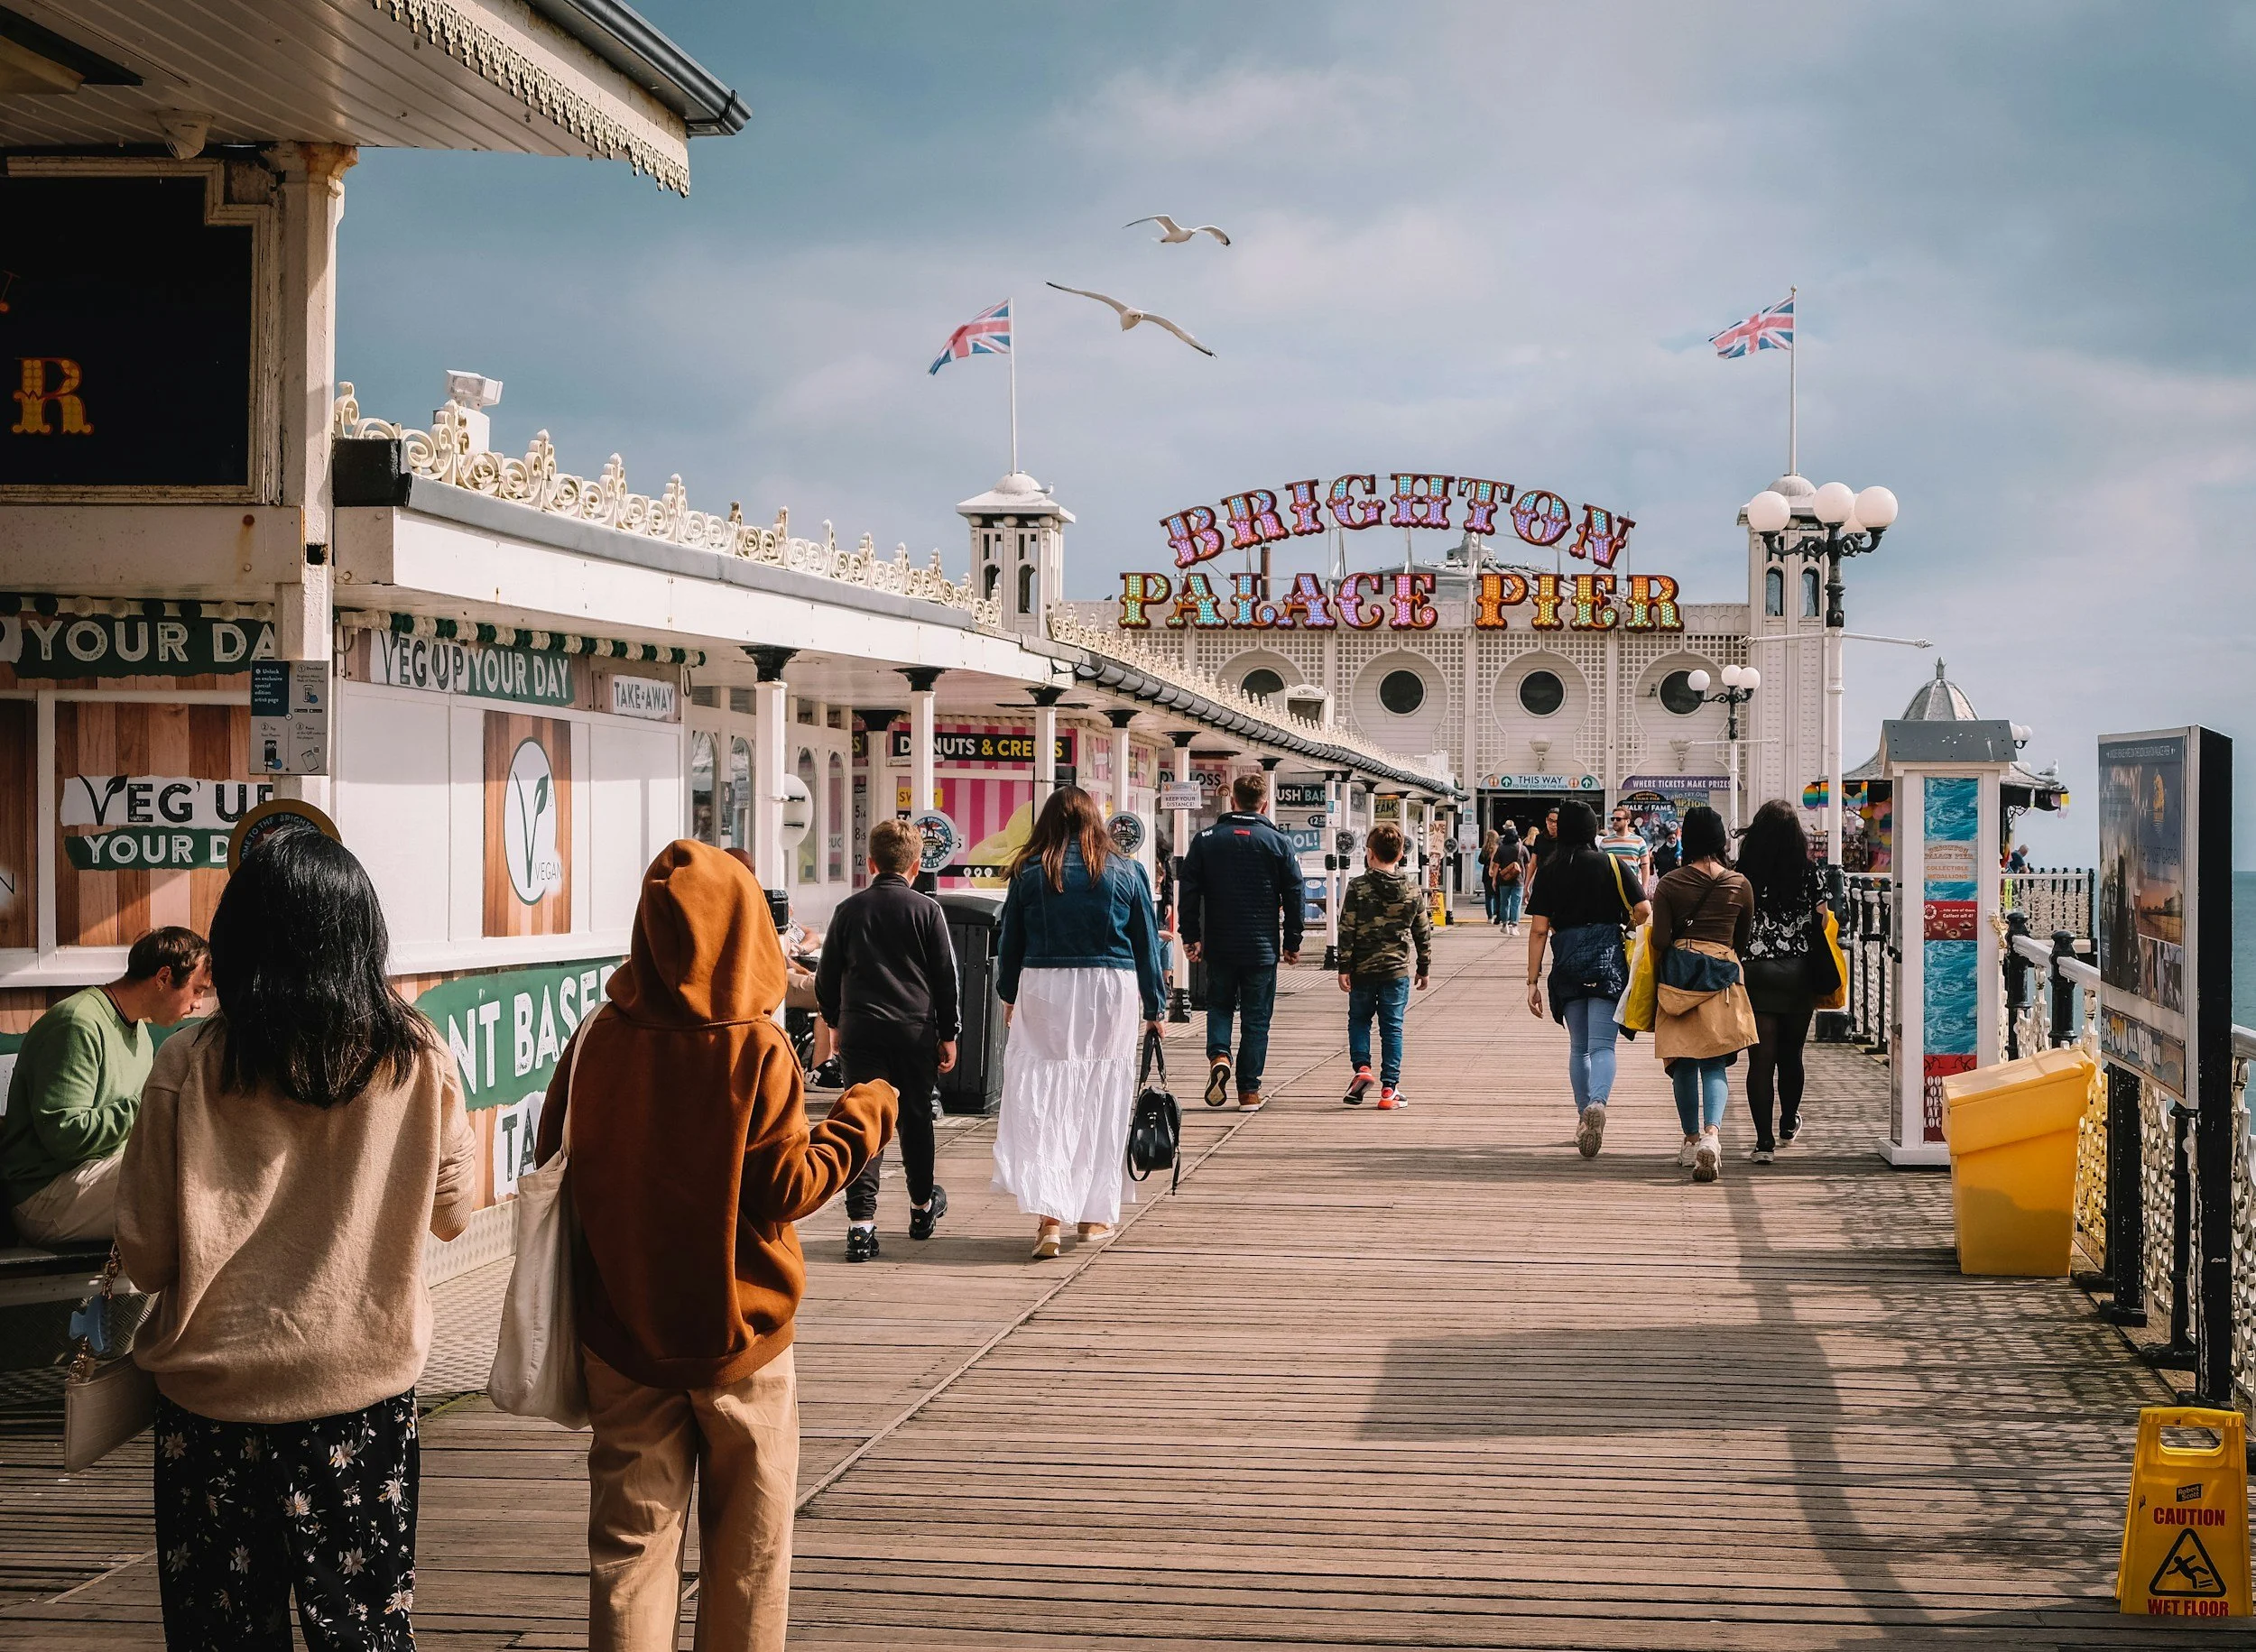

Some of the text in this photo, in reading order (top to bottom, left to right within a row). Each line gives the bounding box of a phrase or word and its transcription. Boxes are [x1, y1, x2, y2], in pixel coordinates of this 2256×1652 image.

[1160, 472, 1635, 569] BRIGHTON
[1117, 572, 1685, 632] PALACE PIER
[28, 621, 274, 662] YOUR DA
[471, 646, 528, 695] YOUR
[533, 656, 569, 699] DAY
[900, 735, 1063, 758] DNUTS & CRES
[1189, 771, 1221, 787] LOSS
[1518, 776, 1563, 784] THIS WAY
[1632, 780, 1731, 789] WHERE TICKETS MAKE PRIZES
[1277, 789, 1301, 801] USH
[1278, 823, 1290, 834] ET
[84, 835, 193, 863] YOUR
[2177, 1484, 2200, 1500] Robert Scott
[2153, 1507, 2225, 1526] CAUTION
[2147, 1599, 2229, 1617] WET FLOOR
